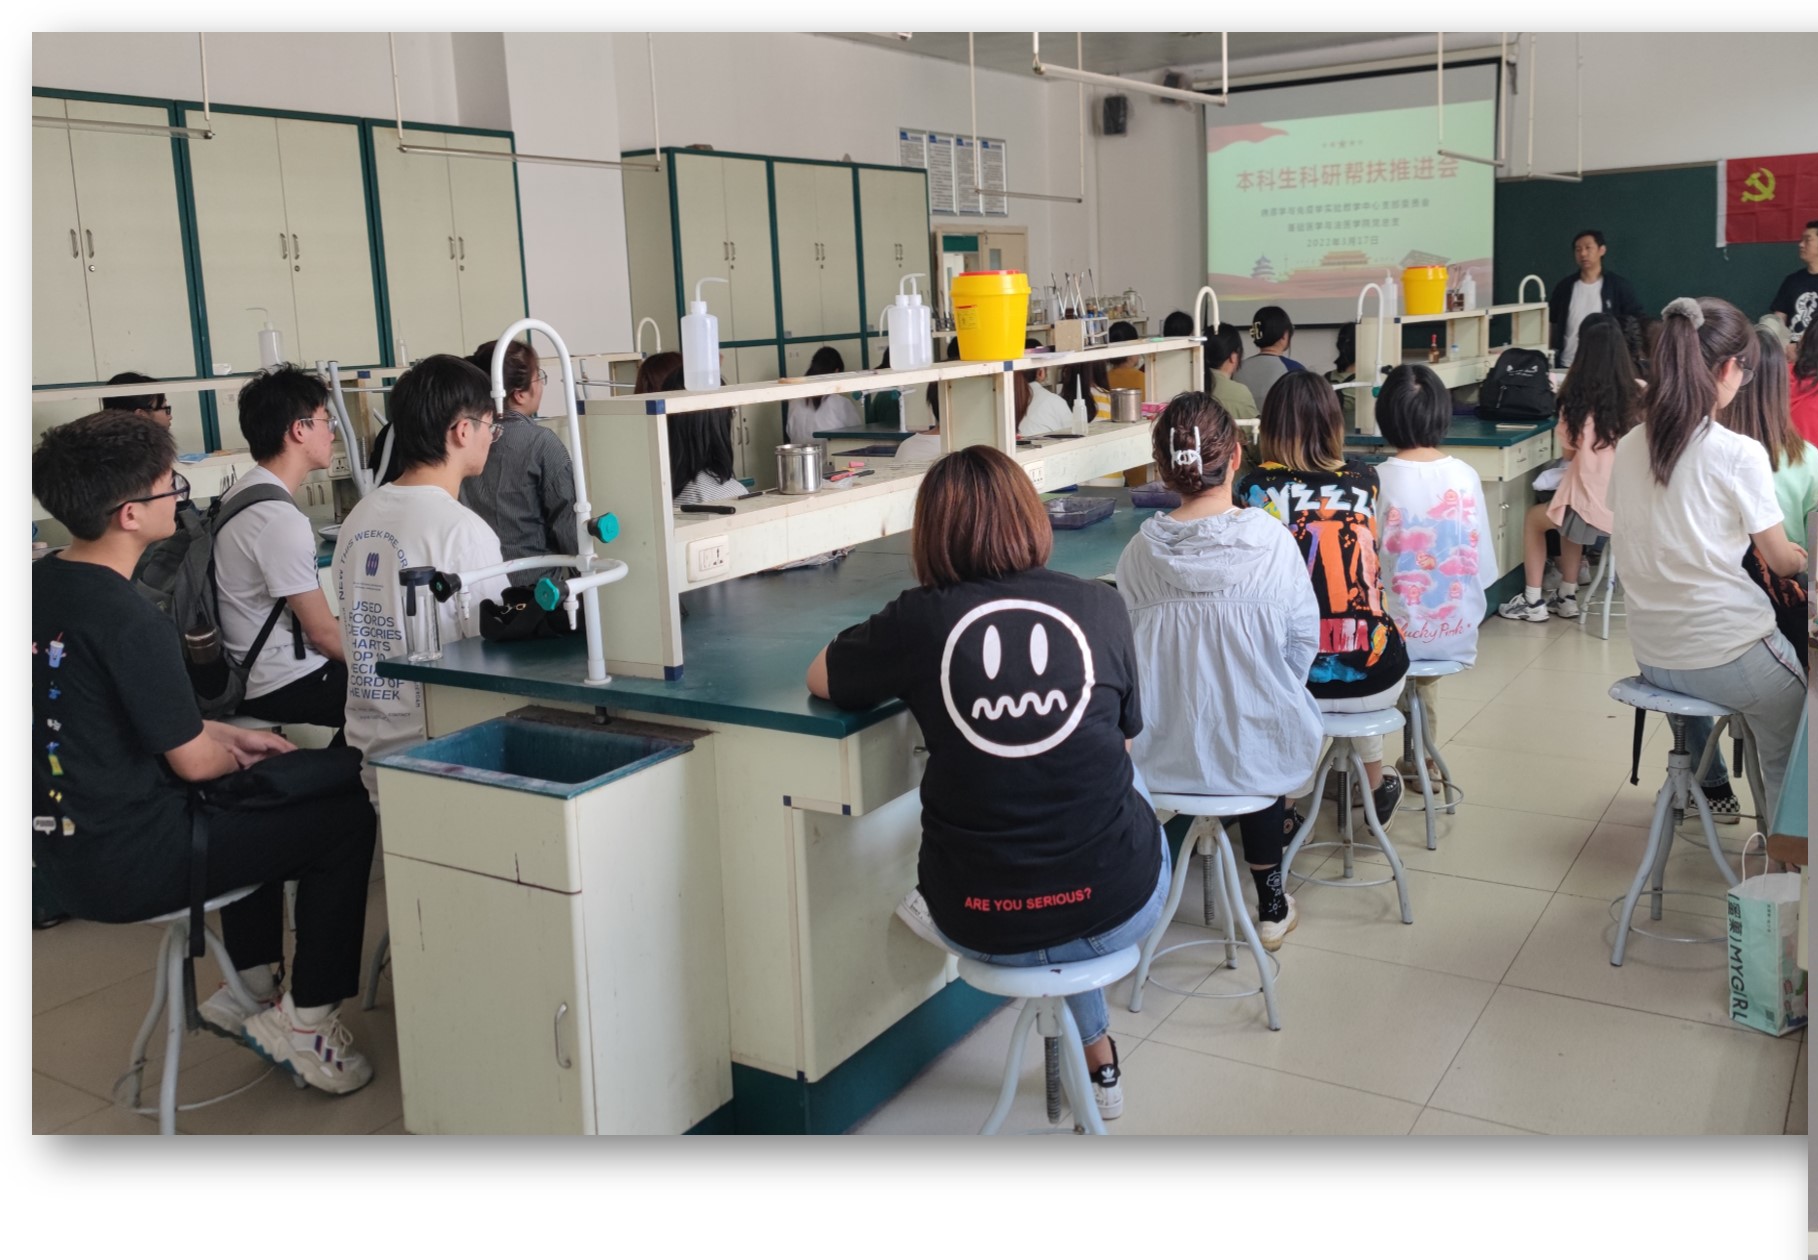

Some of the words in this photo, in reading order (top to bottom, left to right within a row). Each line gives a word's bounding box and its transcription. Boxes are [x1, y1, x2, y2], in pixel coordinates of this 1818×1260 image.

[1236, 155, 1459, 193] 本科生科研帮扶推进会
[354, 529, 383, 542] WEEK
[361, 689, 400, 700] WEEK
[964, 896, 991, 911] ARE
[994, 899, 1022, 911] YOU
[1026, 887, 1092, 910] SERIOUS?
